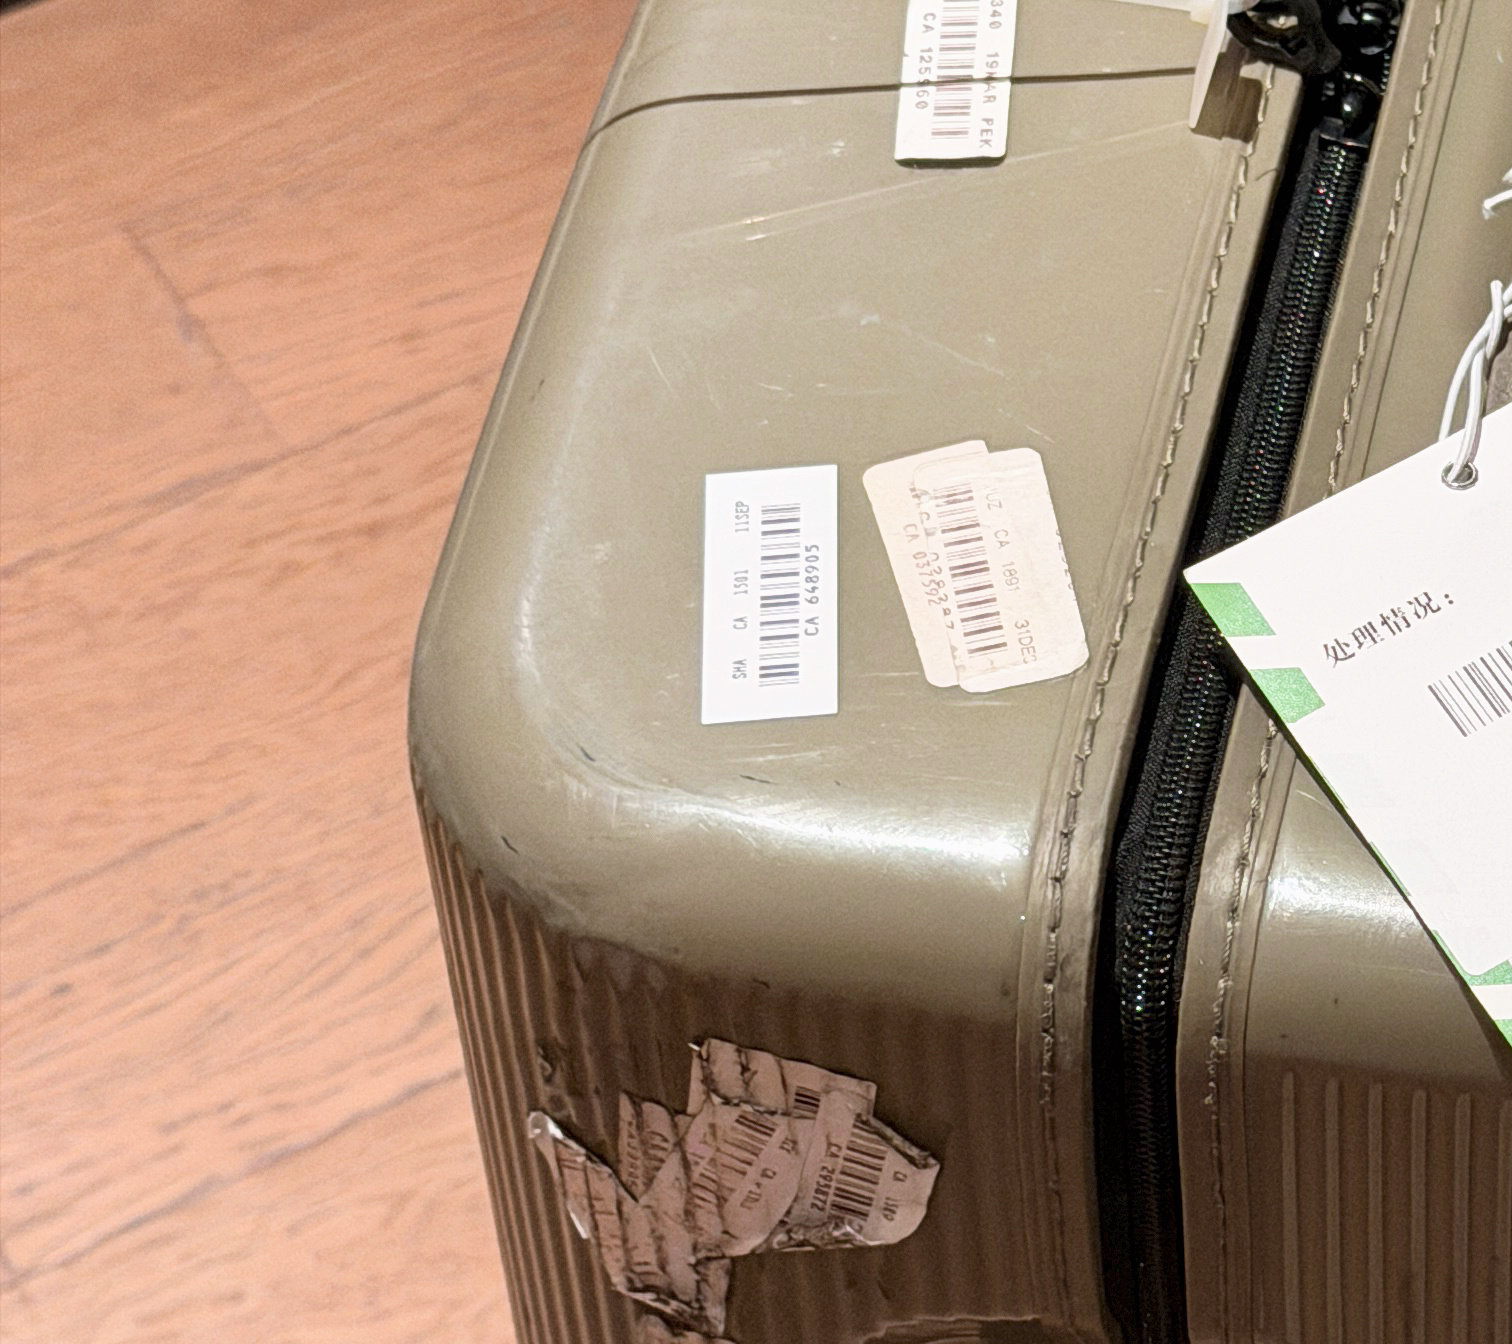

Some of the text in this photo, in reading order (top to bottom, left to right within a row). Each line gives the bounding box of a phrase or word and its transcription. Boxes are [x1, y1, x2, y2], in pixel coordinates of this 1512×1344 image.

[922, 12, 935, 34] CA
[979, 117, 994, 148] PEK
[902, 522, 920, 543] CA
[993, 527, 1011, 549] CA
[732, 501, 749, 679] SHA CA 1501 11SEP
[805, 544, 819, 636] CA 648905
[1319, 582, 1456, 669] 处理情况：
